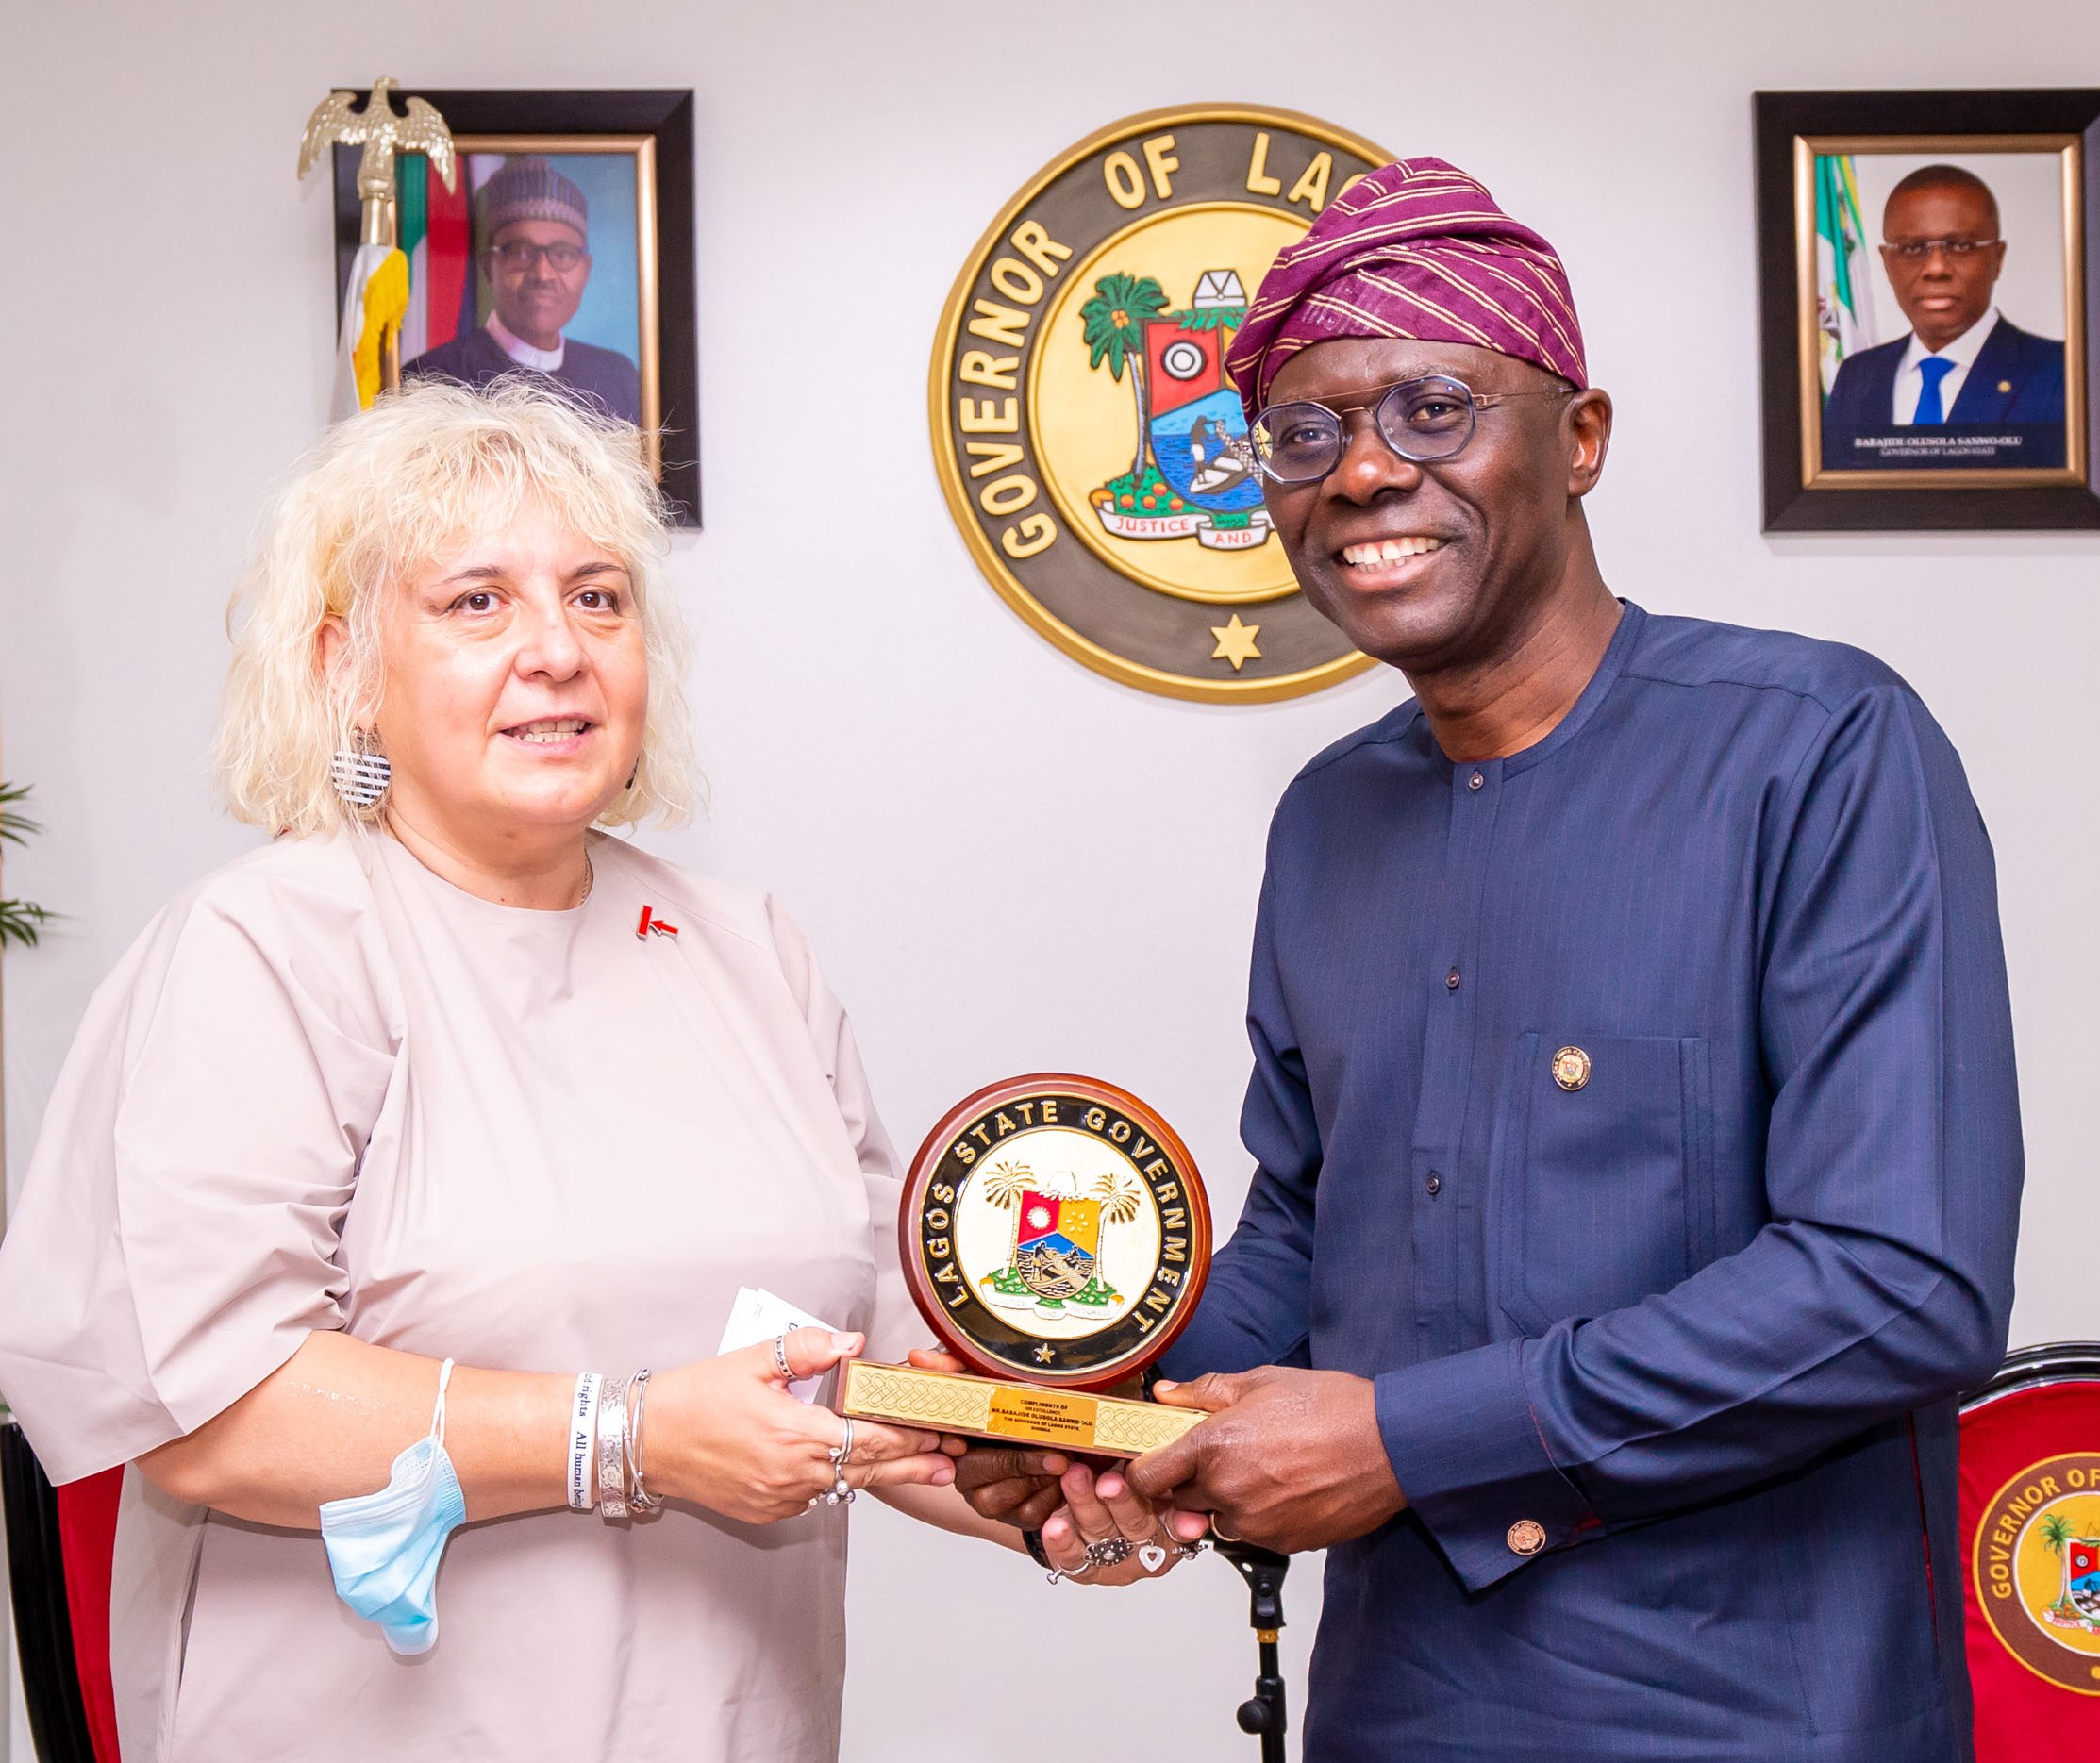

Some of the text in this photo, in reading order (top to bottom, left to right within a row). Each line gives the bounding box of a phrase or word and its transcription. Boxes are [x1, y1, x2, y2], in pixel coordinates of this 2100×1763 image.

[959, 132, 1368, 560] GOVERNOR OF LA
[1116, 516, 1252, 544] JUSTICE AND
[928, 1101, 1188, 1333] LAGOS STATE GOVERNMENT
[578, 1385, 592, 1417] rights
[575, 1431, 587, 1449] All
[574, 1453, 586, 1487] human
[1989, 1468, 2100, 1599] GOVERNOR OF
